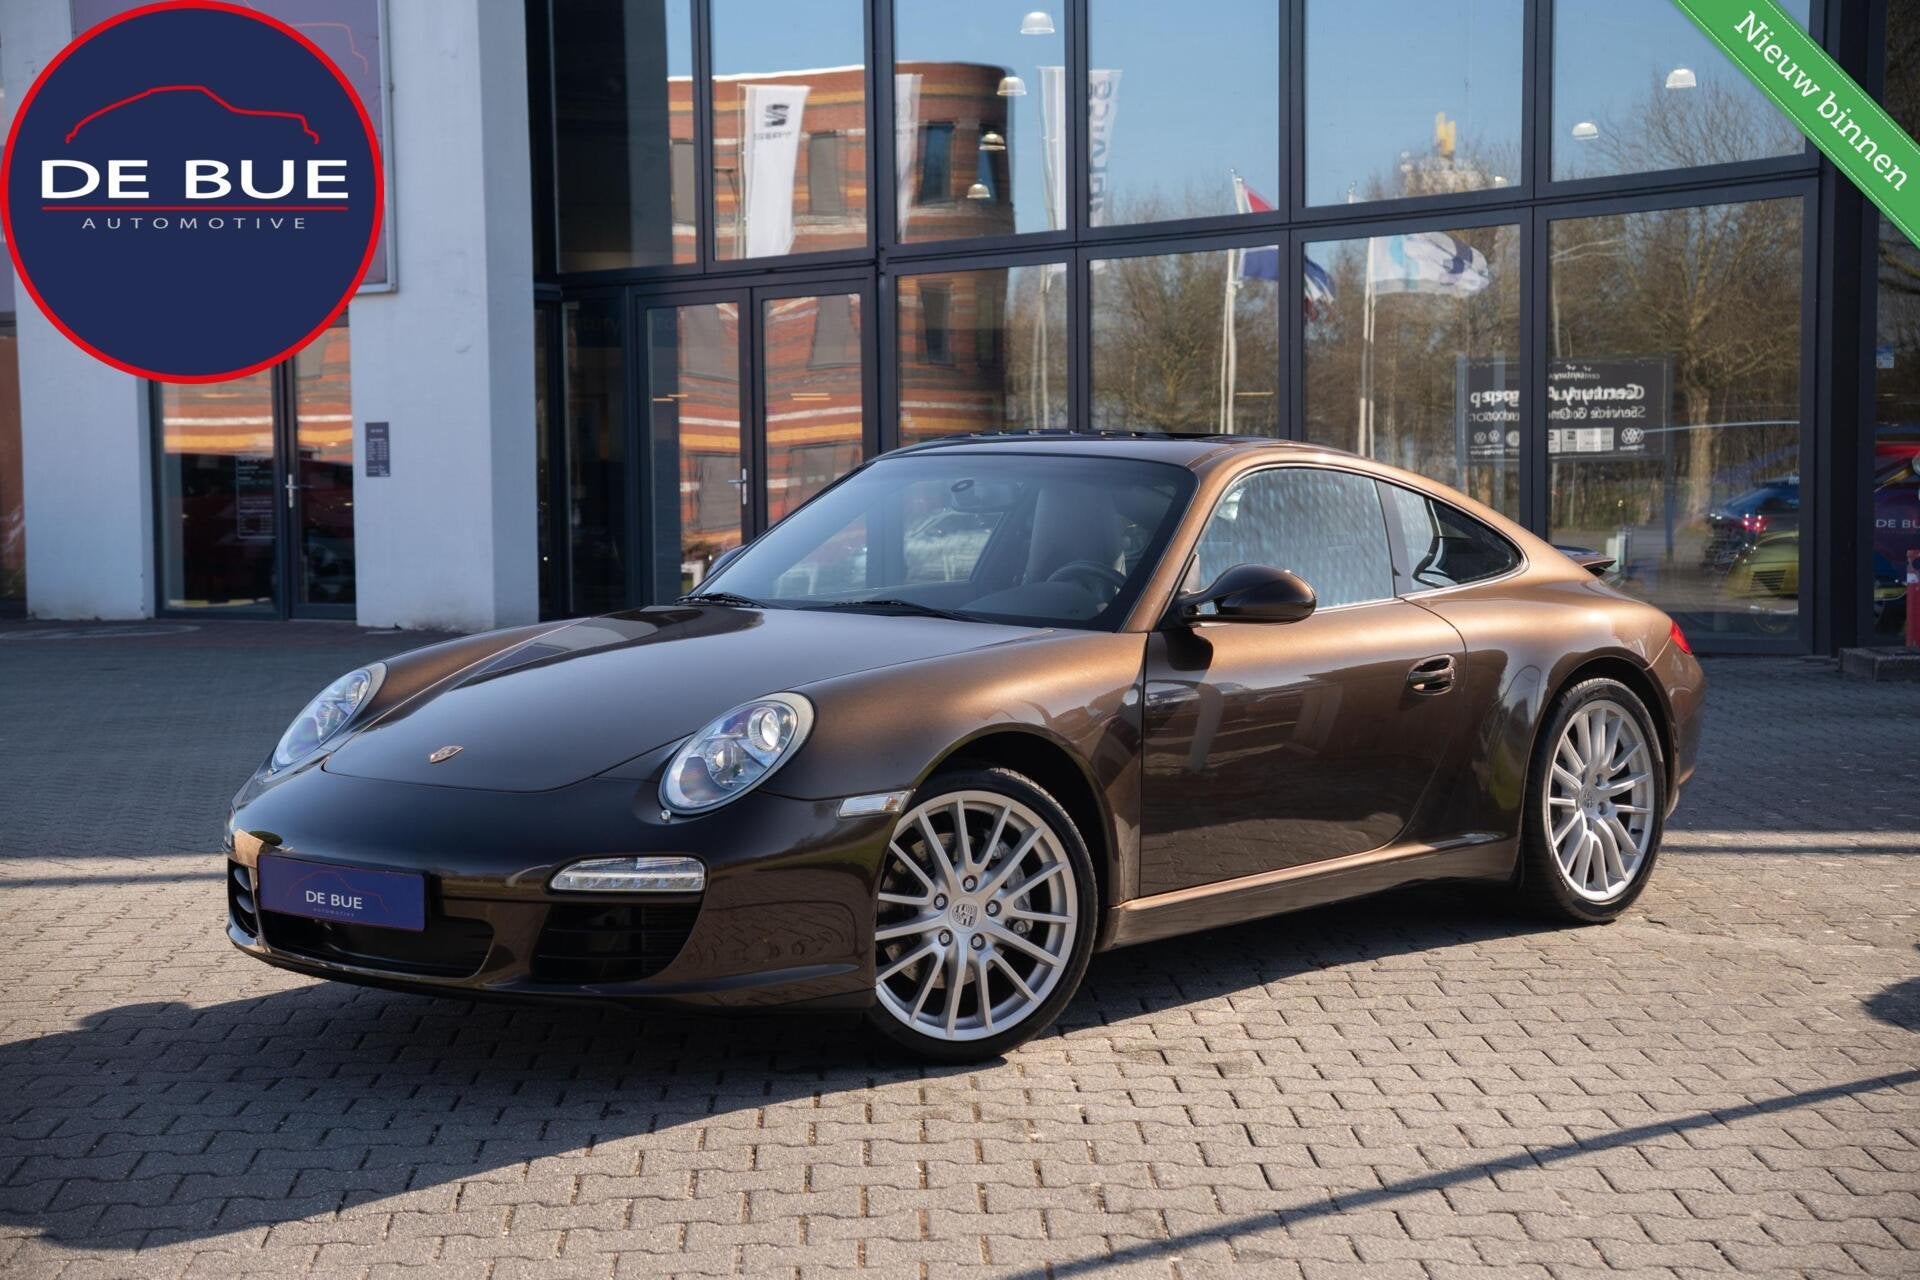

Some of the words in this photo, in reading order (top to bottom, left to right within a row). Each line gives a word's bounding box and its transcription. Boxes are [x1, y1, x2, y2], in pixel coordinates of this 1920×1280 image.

[1875, 519, 1897, 528] DE
[305, 890, 326, 904] DE
[330, 893, 363, 910] BUE
